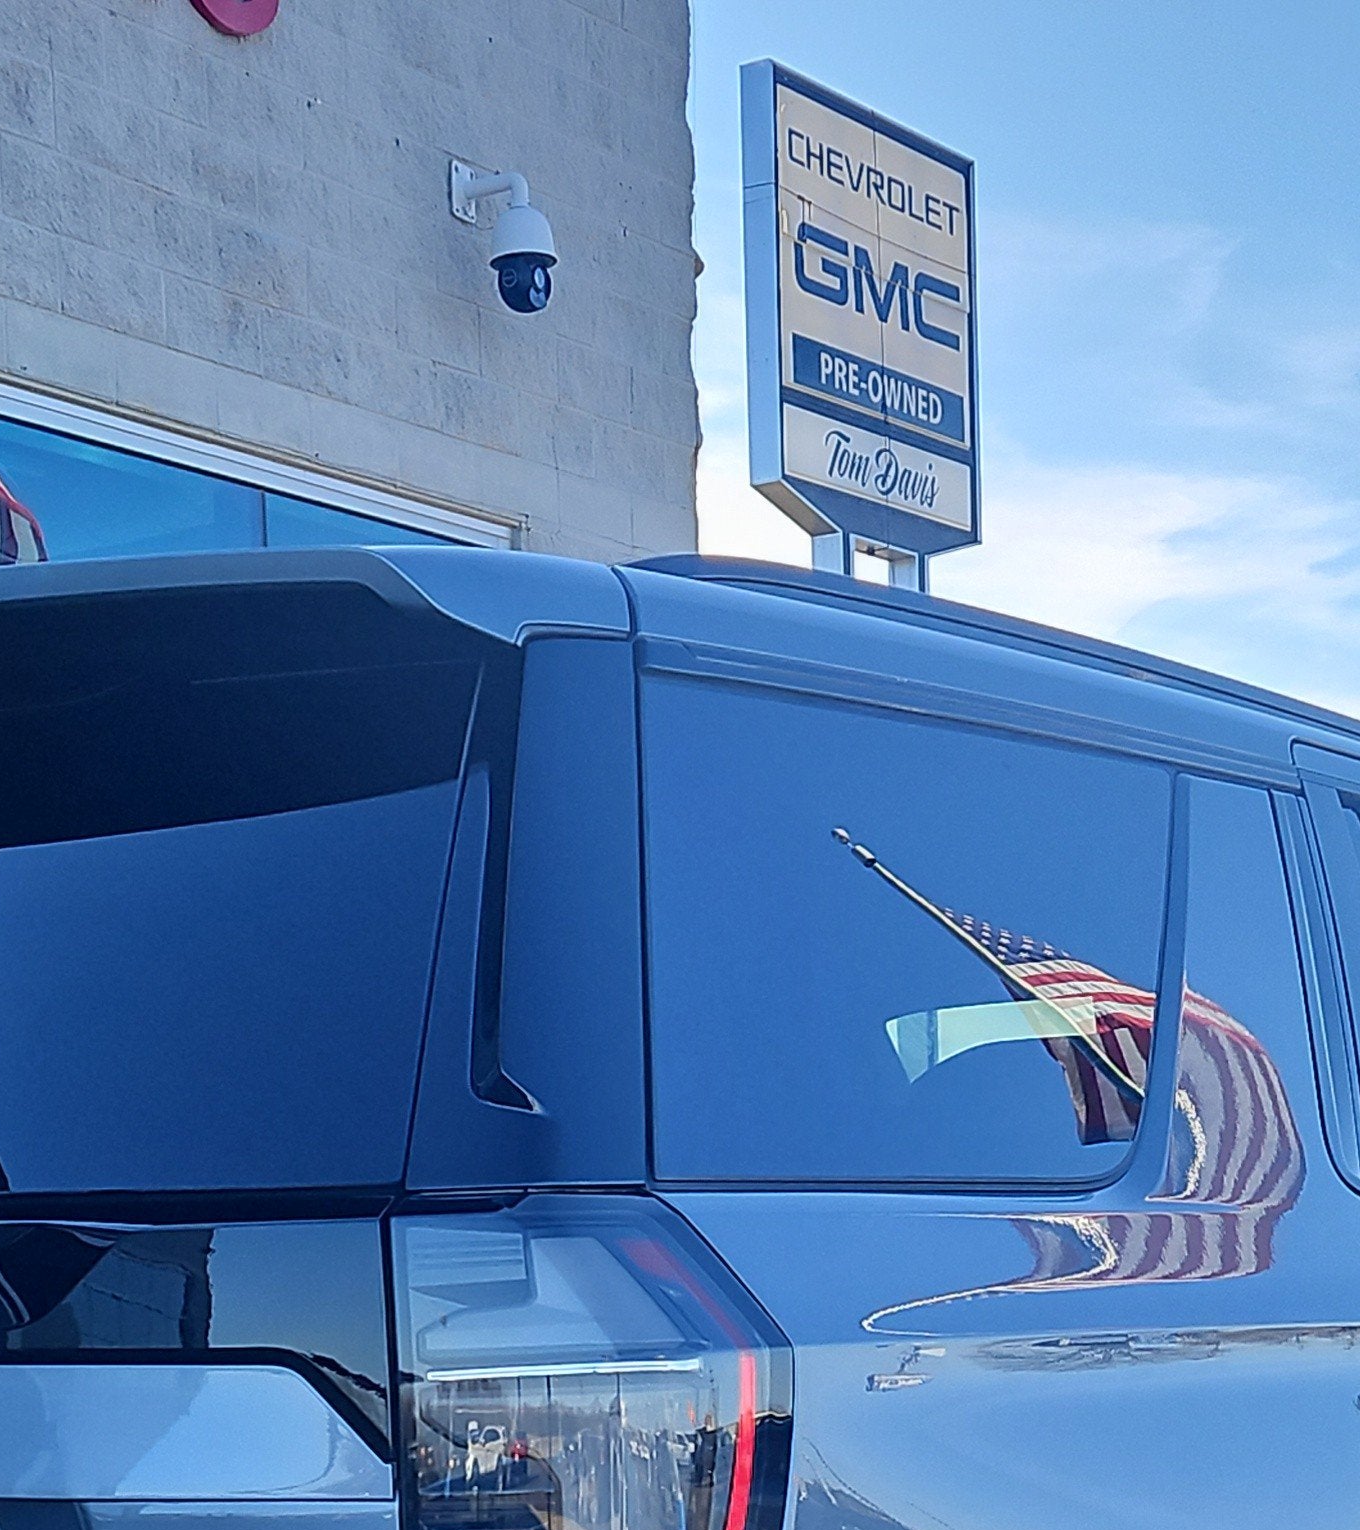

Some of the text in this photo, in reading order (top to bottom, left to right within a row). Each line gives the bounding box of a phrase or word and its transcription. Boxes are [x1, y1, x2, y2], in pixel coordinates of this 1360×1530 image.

[788, 127, 960, 237] CHEVROLET
[794, 221, 961, 353] GMC
[819, 351, 943, 425] PRE-OWNED
[825, 430, 939, 509] Tom Davis
